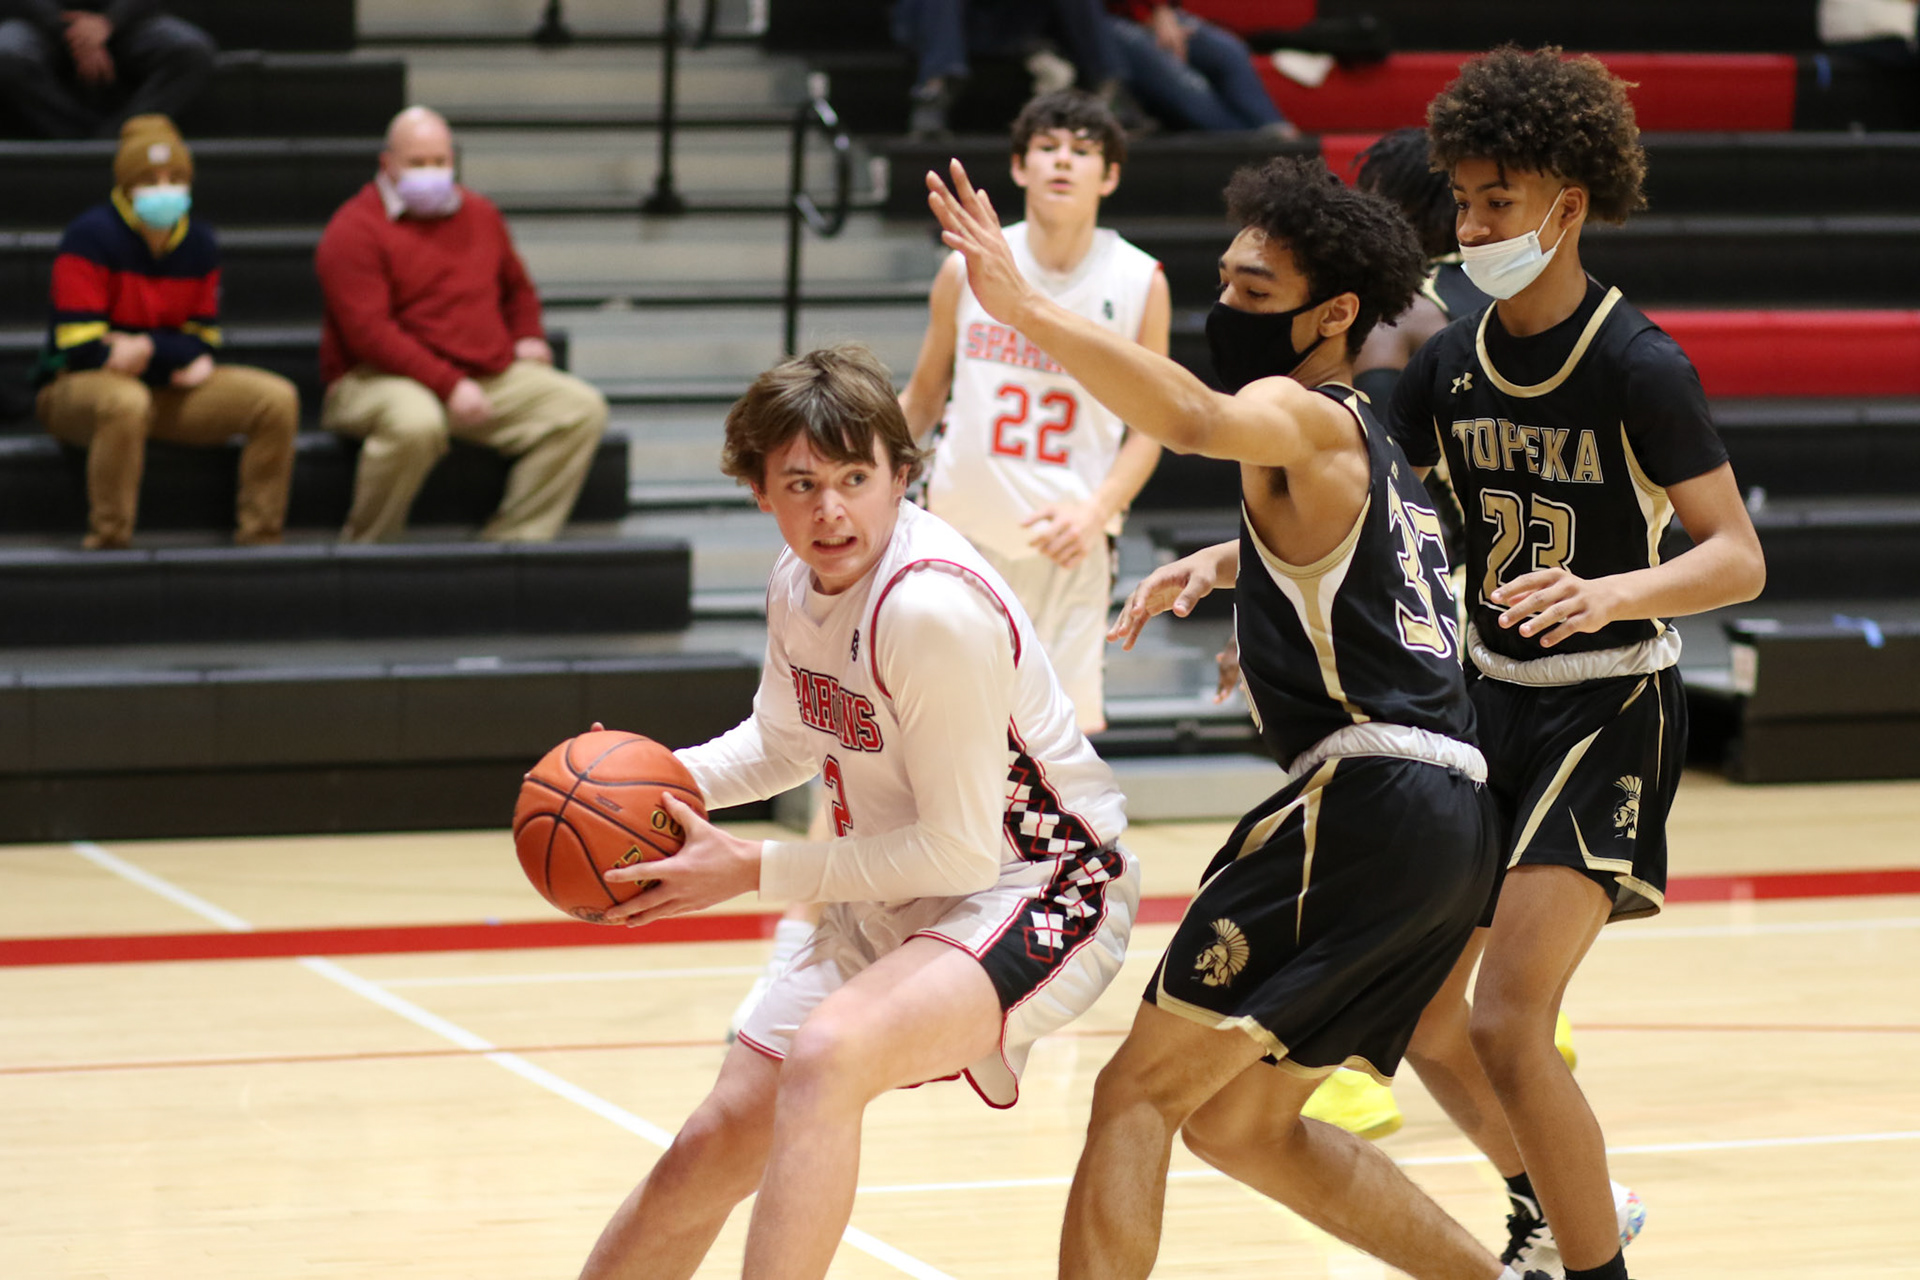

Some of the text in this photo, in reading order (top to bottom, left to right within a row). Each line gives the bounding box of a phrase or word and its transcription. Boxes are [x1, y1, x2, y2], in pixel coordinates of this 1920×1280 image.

[991, 382, 1076, 467] 22
[1452, 418, 1604, 484] TOPEKA
[1479, 488, 1576, 616] 23
[823, 754, 853, 837] 2
